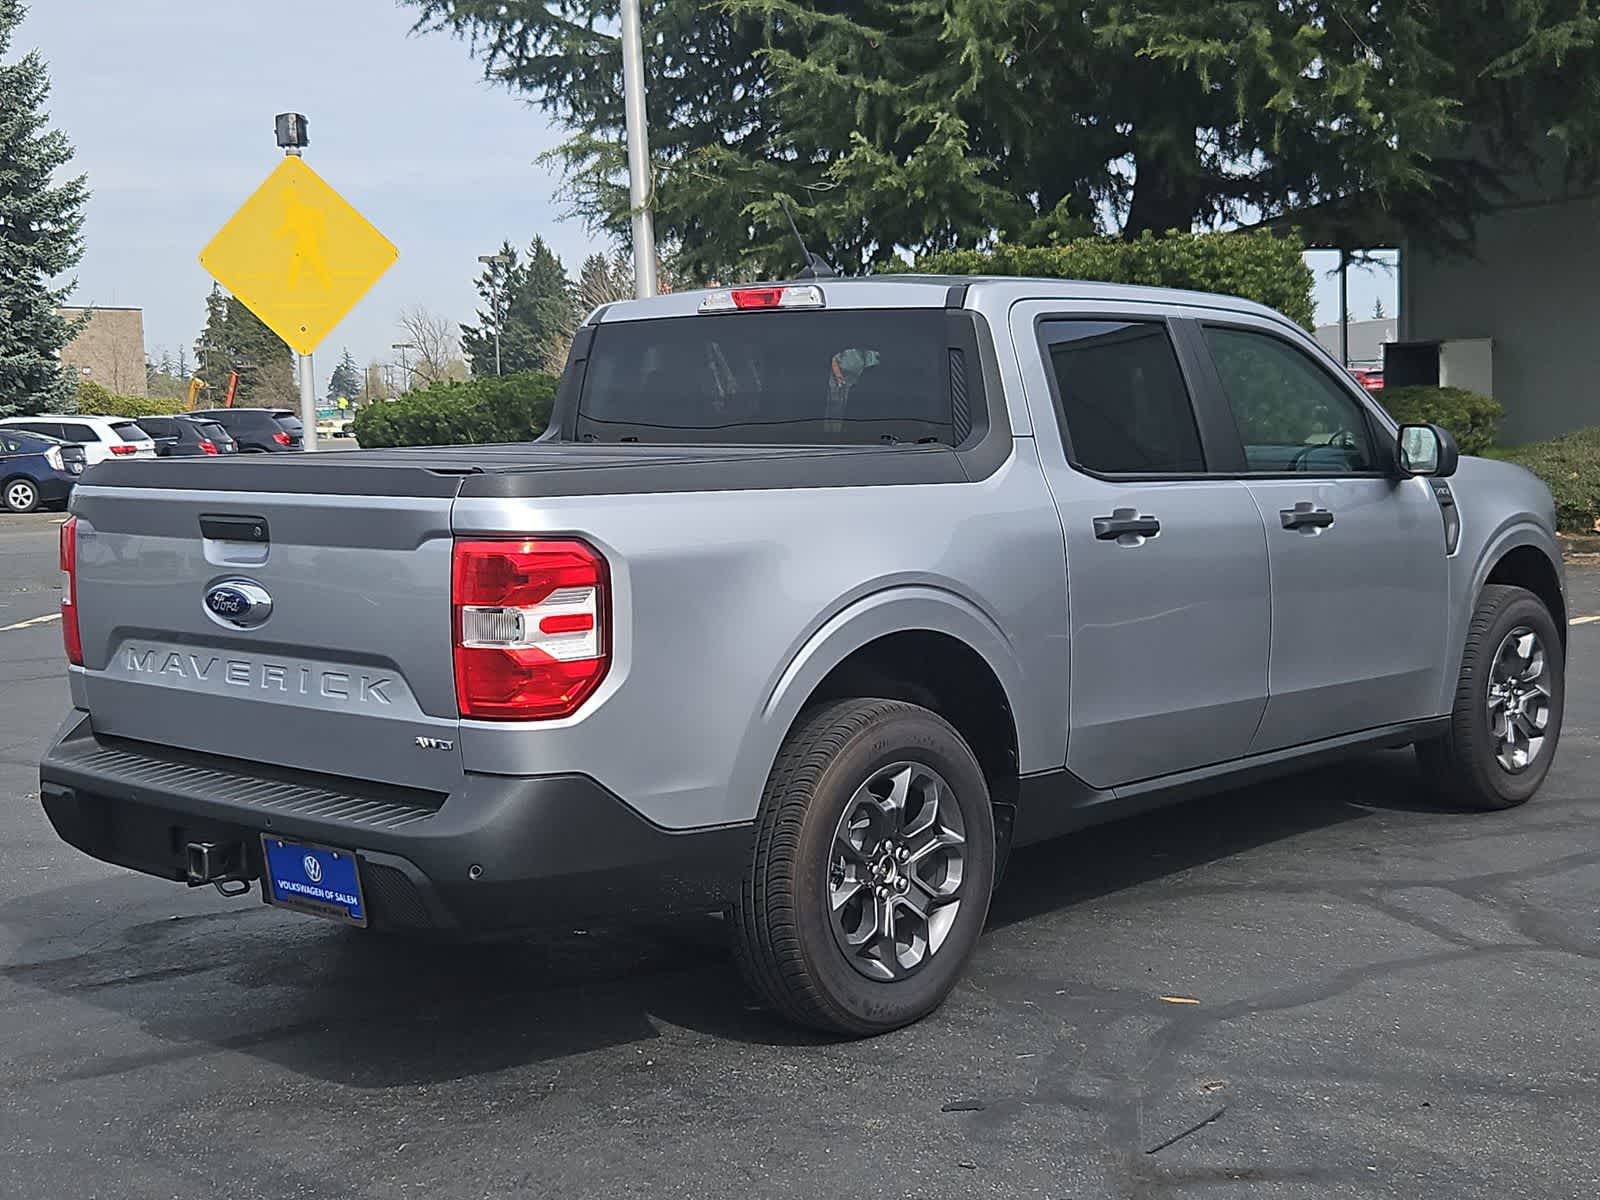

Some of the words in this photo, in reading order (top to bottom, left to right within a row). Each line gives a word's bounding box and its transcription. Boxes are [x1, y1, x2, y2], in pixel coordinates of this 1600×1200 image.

[212, 591, 241, 613] Ford
[126, 646, 393, 705] MAVERICK
[277, 880, 325, 898] VOLKSWAGEN
[324, 889, 334, 900] OF
[334, 892, 358, 906] SALEM
